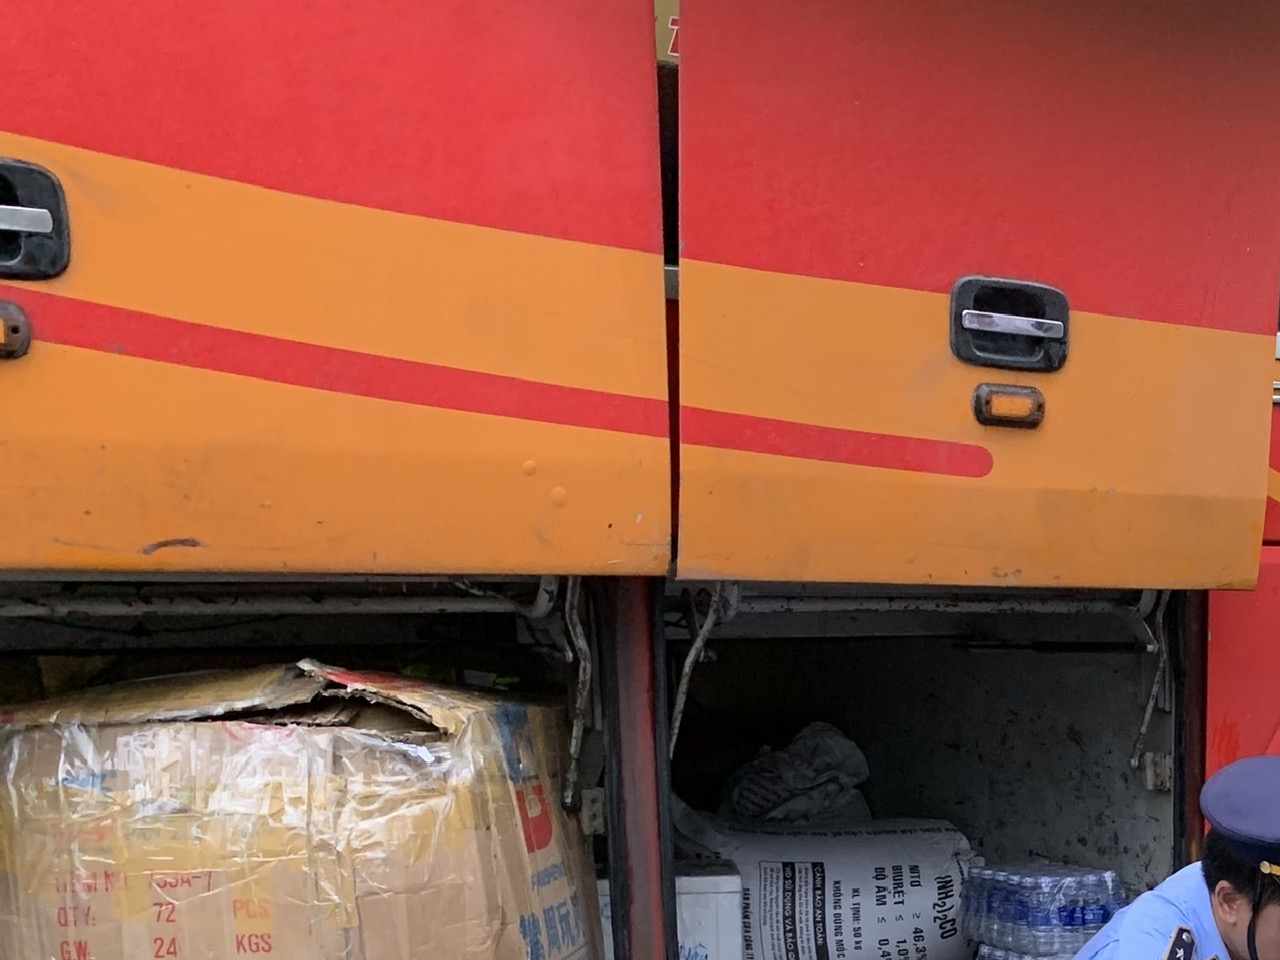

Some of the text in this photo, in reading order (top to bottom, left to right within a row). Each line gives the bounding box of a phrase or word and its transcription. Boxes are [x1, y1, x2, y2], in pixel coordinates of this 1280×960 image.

[153, 903, 177, 923] 72
[233, 898, 271, 919] PCS
[853, 926, 862, 938] 50
[153, 937, 178, 959] 24
[236, 933, 272, 955] KGS
